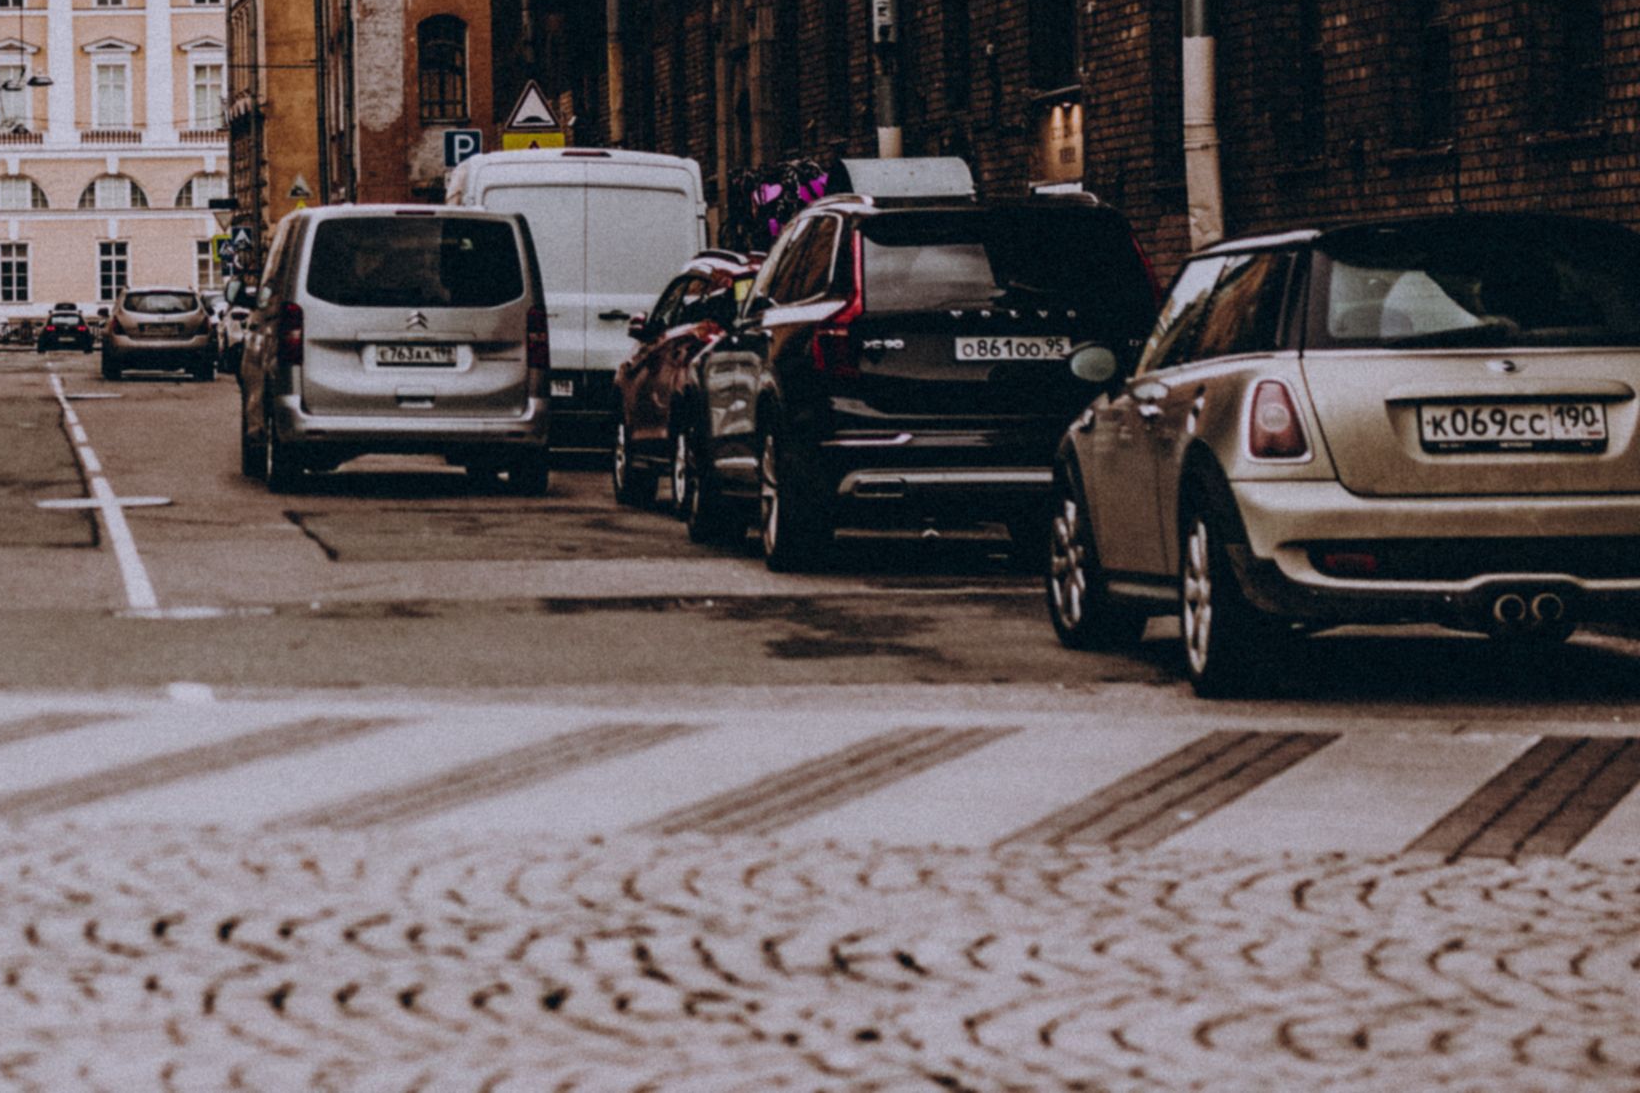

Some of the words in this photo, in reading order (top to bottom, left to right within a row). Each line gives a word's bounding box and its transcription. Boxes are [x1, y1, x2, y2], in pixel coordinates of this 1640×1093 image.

[454, 134, 475, 163] P
[1431, 408, 1546, 436] К069СС
[1554, 405, 1596, 427] 190
